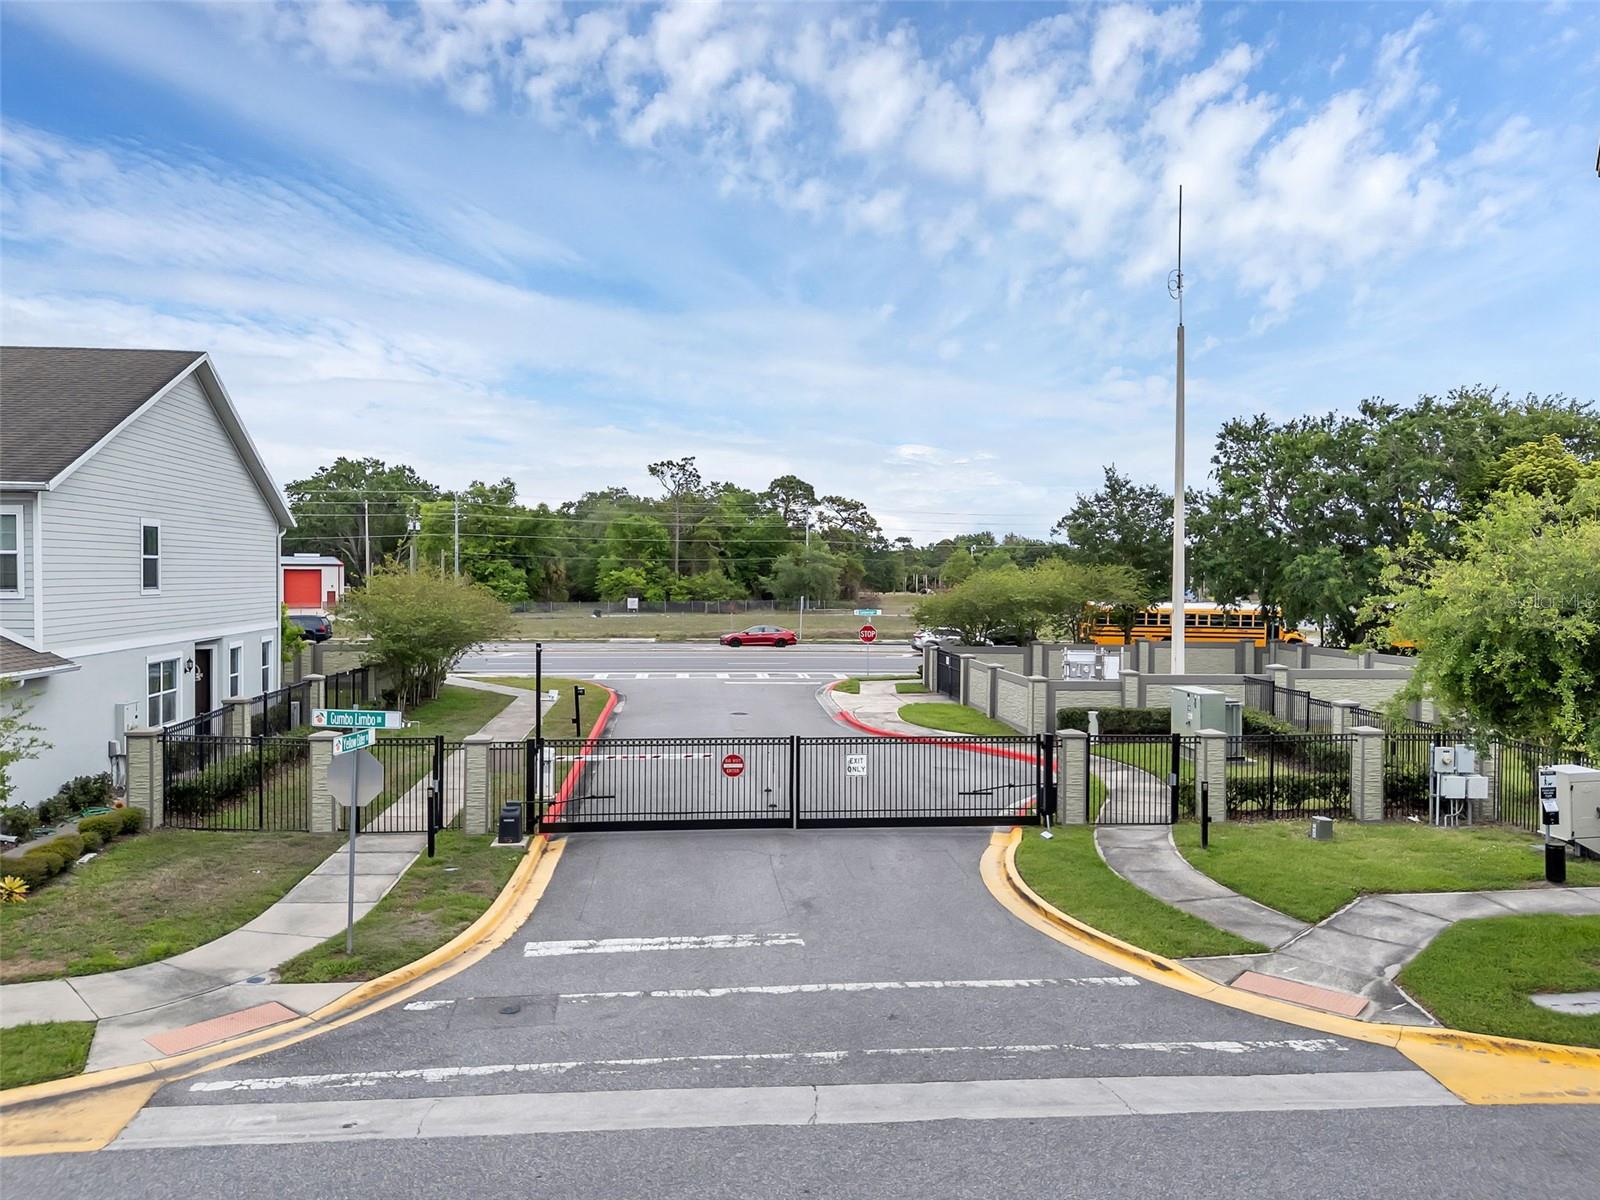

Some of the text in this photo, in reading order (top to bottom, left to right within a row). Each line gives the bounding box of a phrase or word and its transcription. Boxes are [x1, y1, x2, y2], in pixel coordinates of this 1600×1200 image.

[860, 630, 876, 638] STOP
[330, 712, 353, 725] Gumbo
[354, 712, 376, 726] Limbo
[342, 737, 356, 750] Yellow
